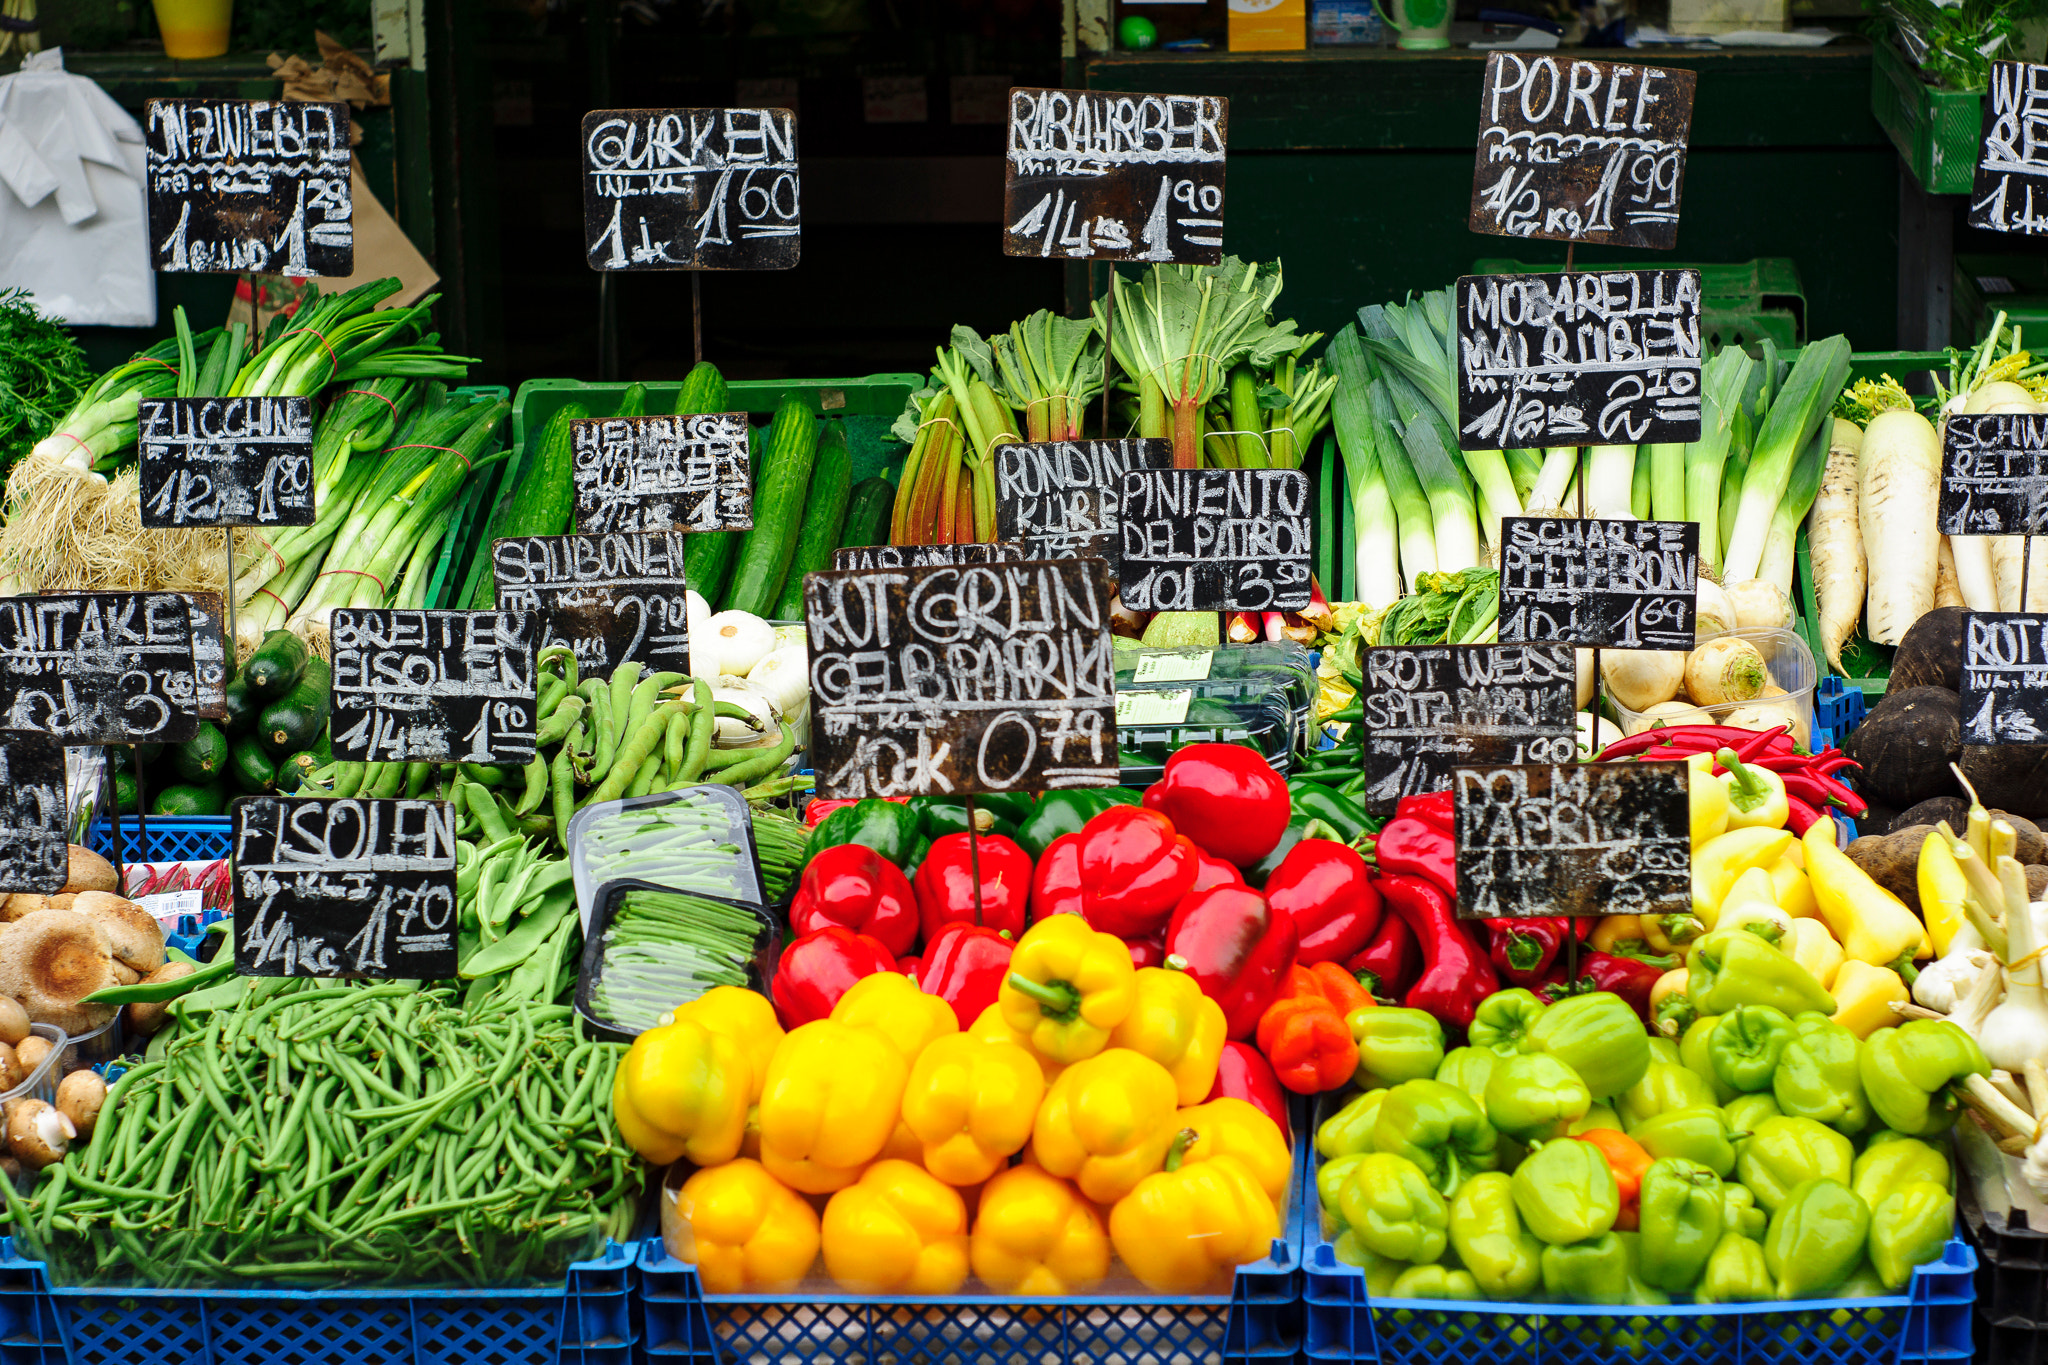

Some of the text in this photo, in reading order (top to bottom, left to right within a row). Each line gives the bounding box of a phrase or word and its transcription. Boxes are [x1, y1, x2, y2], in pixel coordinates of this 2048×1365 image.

[1491, 53, 1667, 132] POREE
[588, 109, 797, 172] GURKEN
[1369, 649, 1451, 691] ROT
